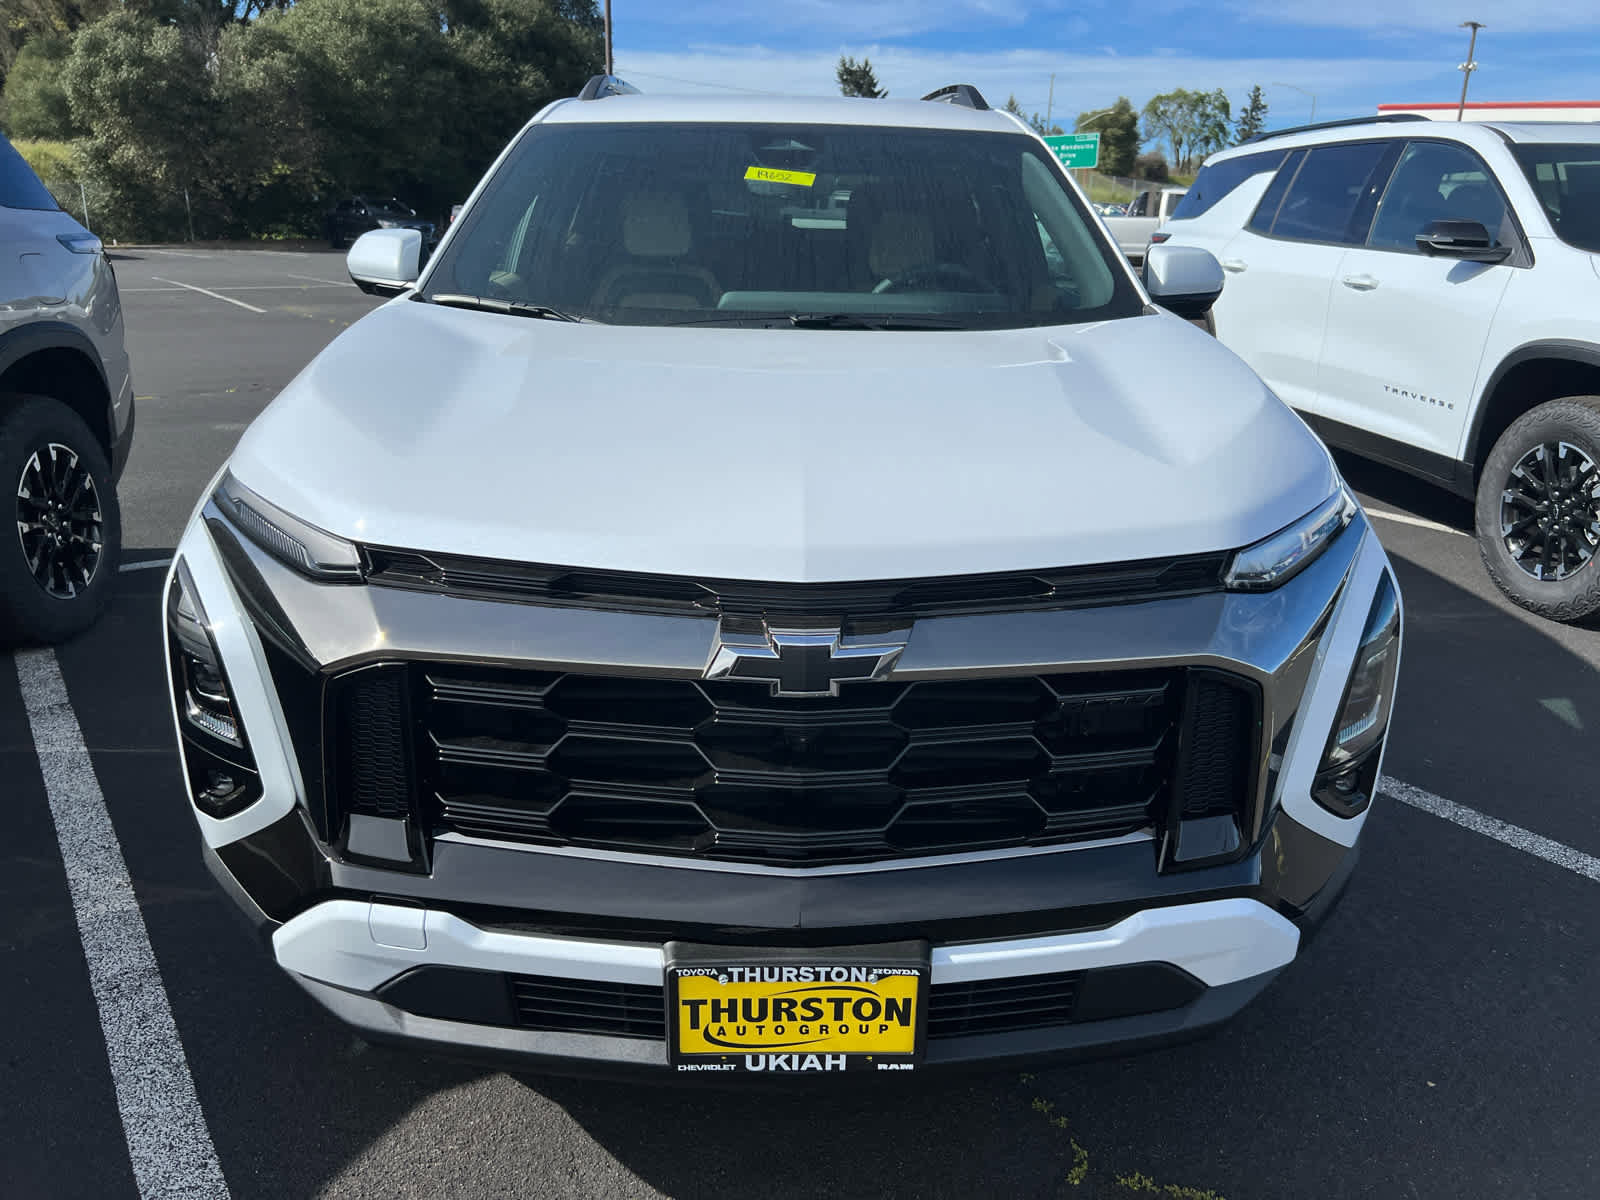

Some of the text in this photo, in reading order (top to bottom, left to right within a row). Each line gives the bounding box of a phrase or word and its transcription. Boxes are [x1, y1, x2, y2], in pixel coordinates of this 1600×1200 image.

[1383, 384, 1455, 410] TRAVERSE
[676, 968, 718, 977] TOYOTA
[727, 967, 867, 983] THURSTON
[872, 968, 921, 976] HONDA
[682, 997, 912, 1030] THURSTON
[716, 1024, 890, 1037] AUTO GROUP
[677, 1064, 737, 1072] CHEVROLET
[744, 1054, 848, 1072] UKIAH
